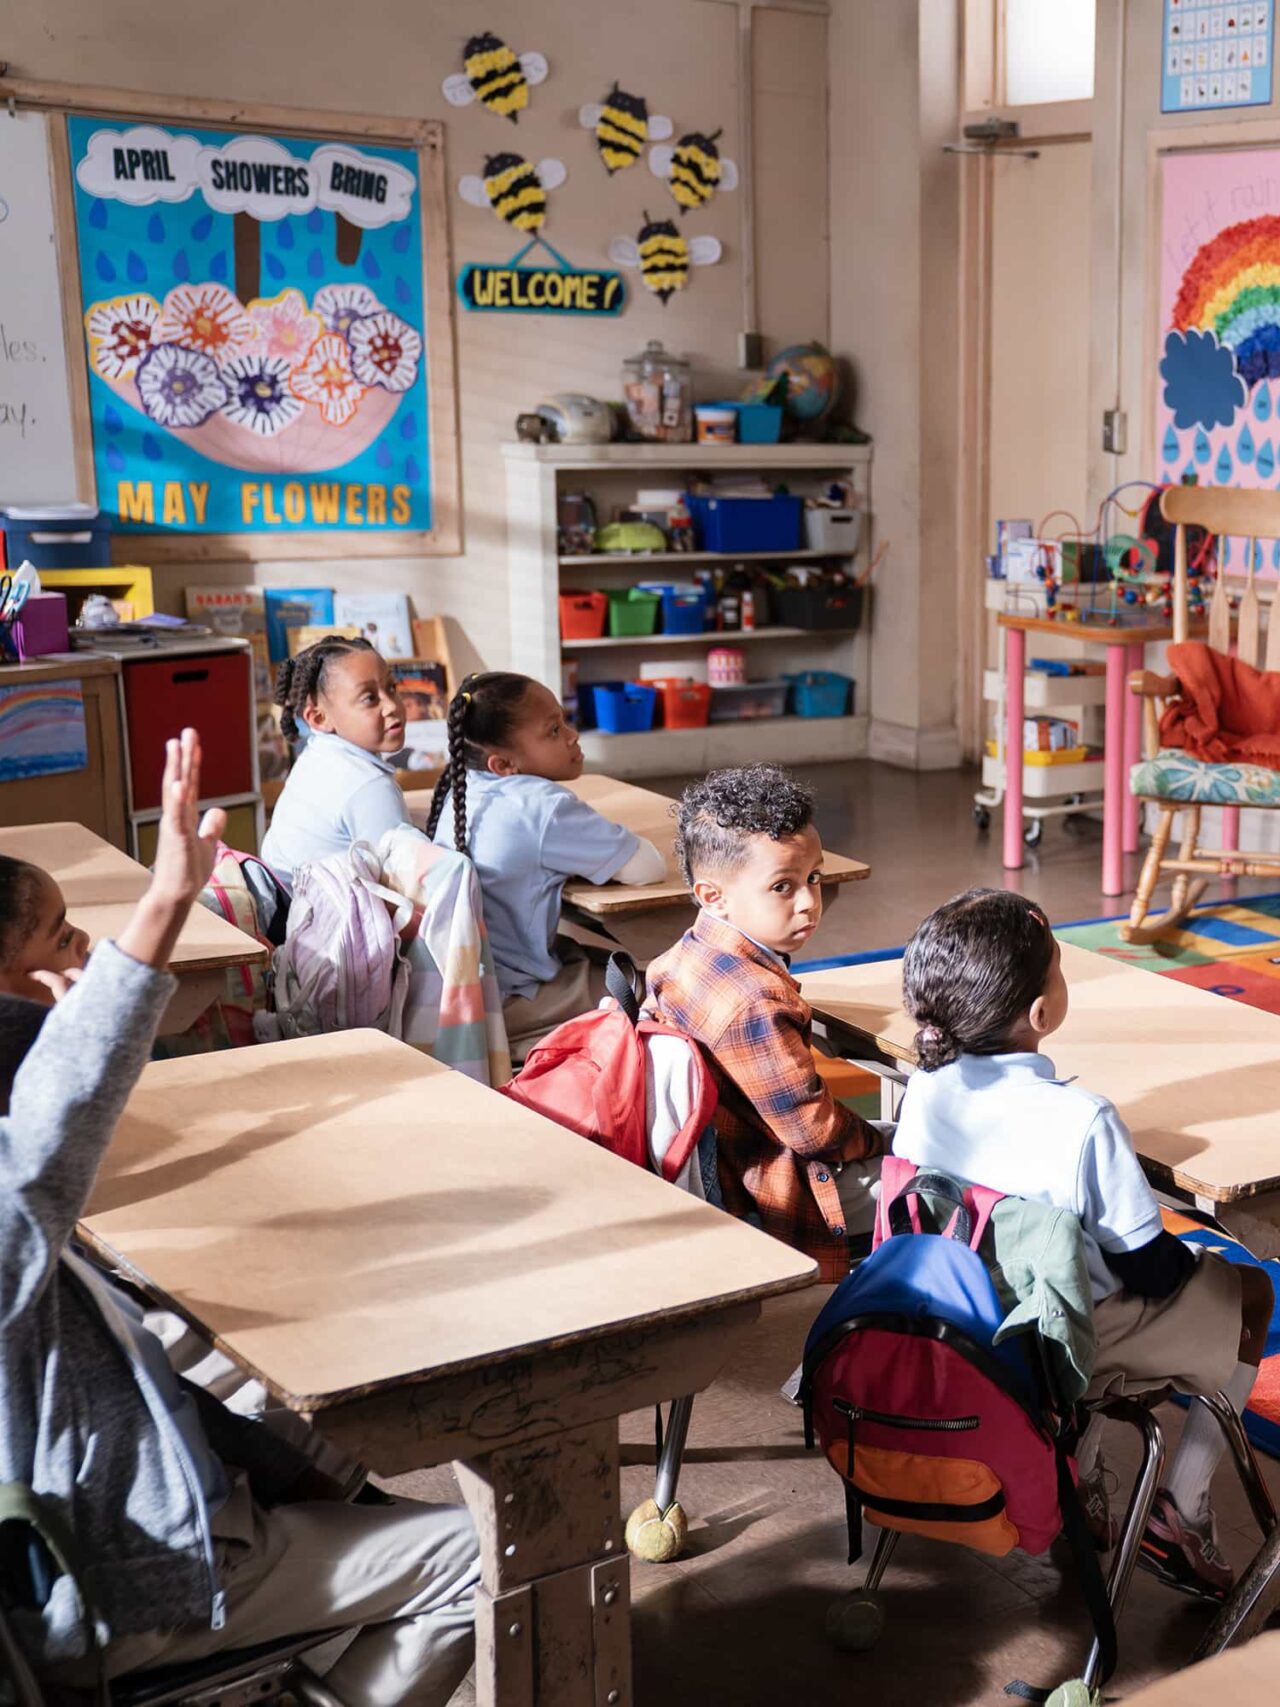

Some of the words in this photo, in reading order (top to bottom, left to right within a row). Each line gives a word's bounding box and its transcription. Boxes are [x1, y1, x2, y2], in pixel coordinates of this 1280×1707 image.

[113, 148, 176, 181] APRIL
[211, 159, 310, 198] SHOWERS
[330, 161, 388, 204] BRING
[472, 268, 619, 309] WELCOME!
[117, 480, 209, 524] MAY
[241, 481, 412, 525] FLOWERS
